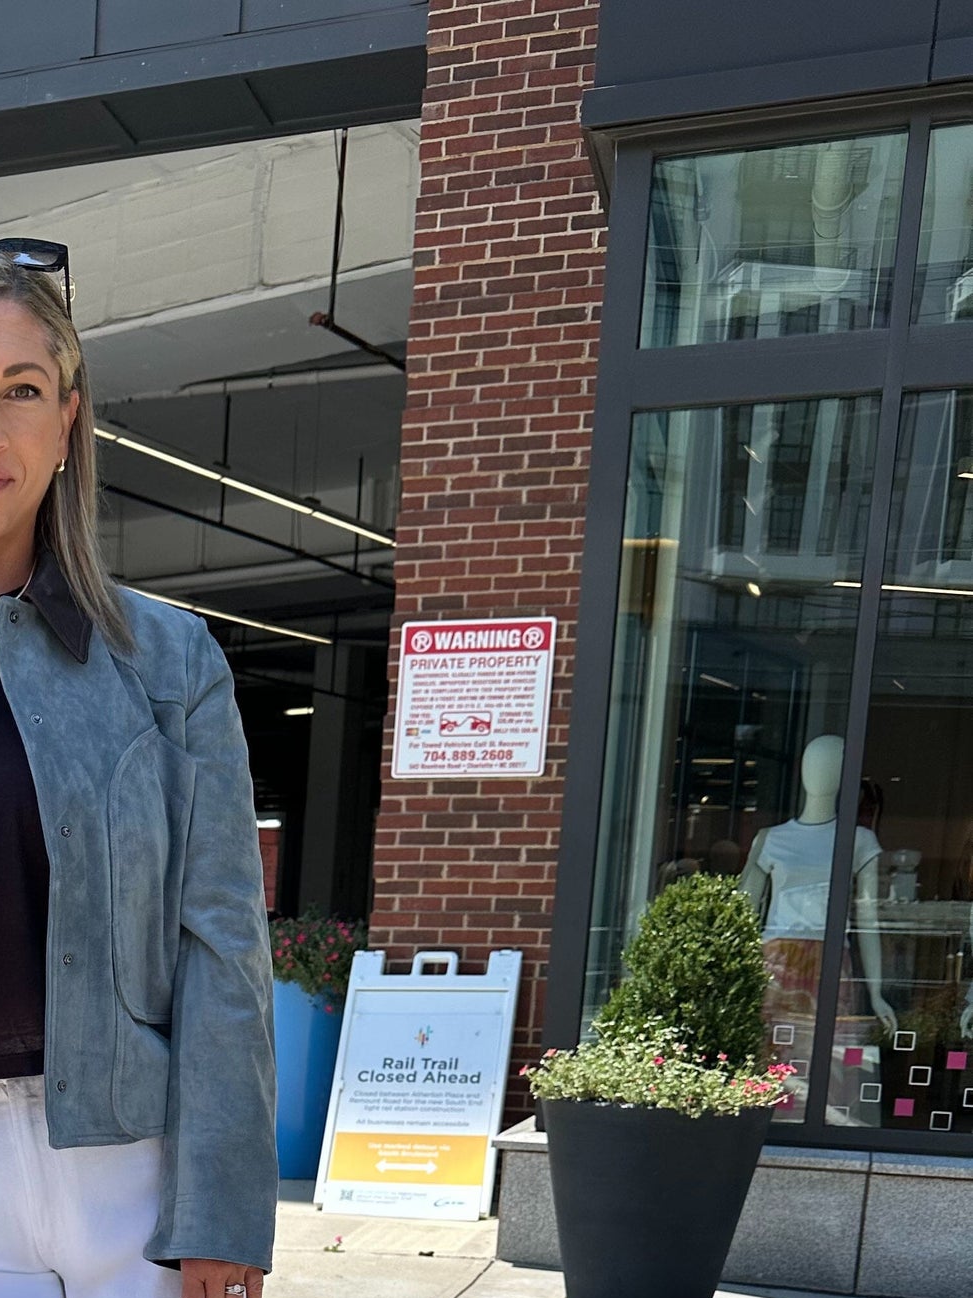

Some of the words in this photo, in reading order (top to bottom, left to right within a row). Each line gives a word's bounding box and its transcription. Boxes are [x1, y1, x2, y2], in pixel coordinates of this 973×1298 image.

[434, 629, 522, 650] WARNING
[410, 657, 465, 670] PRIVATE
[468, 655, 542, 669] PROPERTY
[423, 749, 514, 761] 704.889.2608
[382, 1057, 415, 1071] Rail
[422, 1058, 459, 1071] Trail
[357, 1070, 417, 1083] Closed
[423, 1071, 481, 1085] Ahead
